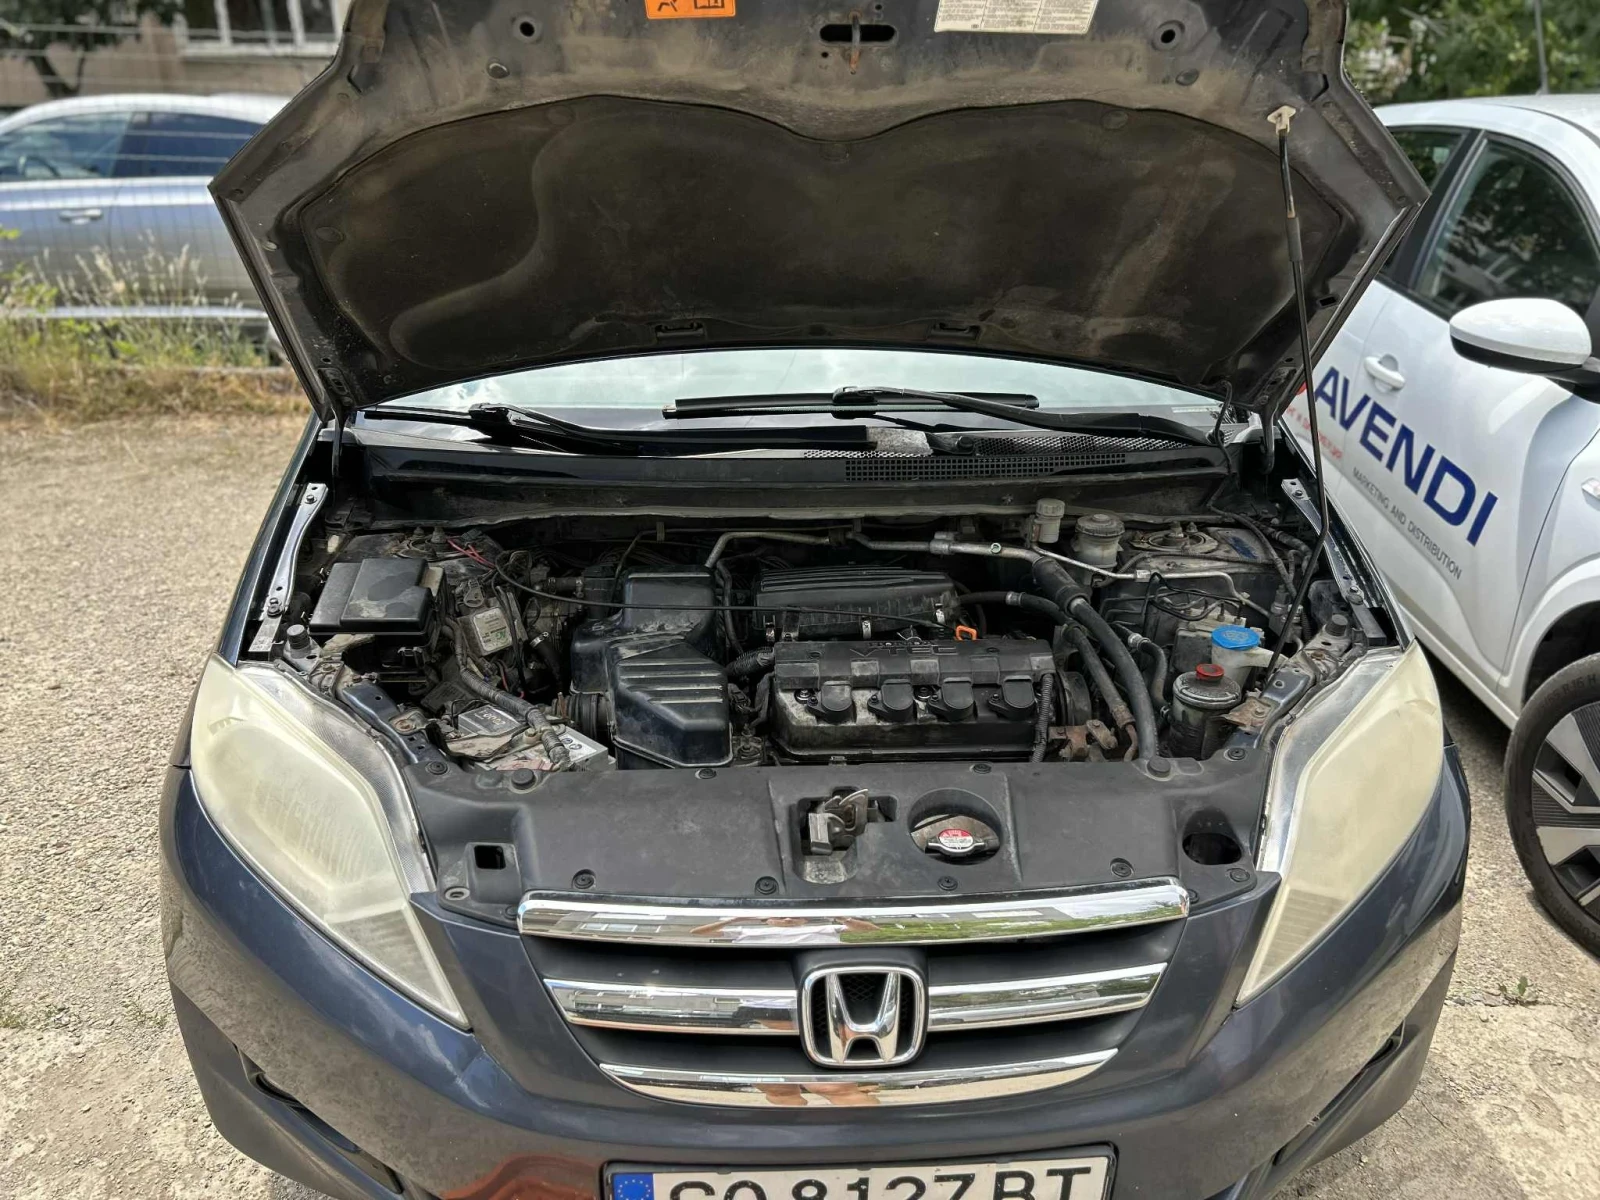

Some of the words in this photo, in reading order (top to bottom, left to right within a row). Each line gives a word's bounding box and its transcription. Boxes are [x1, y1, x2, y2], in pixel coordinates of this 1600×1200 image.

[1314, 366, 1499, 547] AVENDI
[1353, 467, 1390, 509] MARKETING
[1391, 505, 1407, 526] AND
[1408, 521, 1463, 580] DISTRIBUTION
